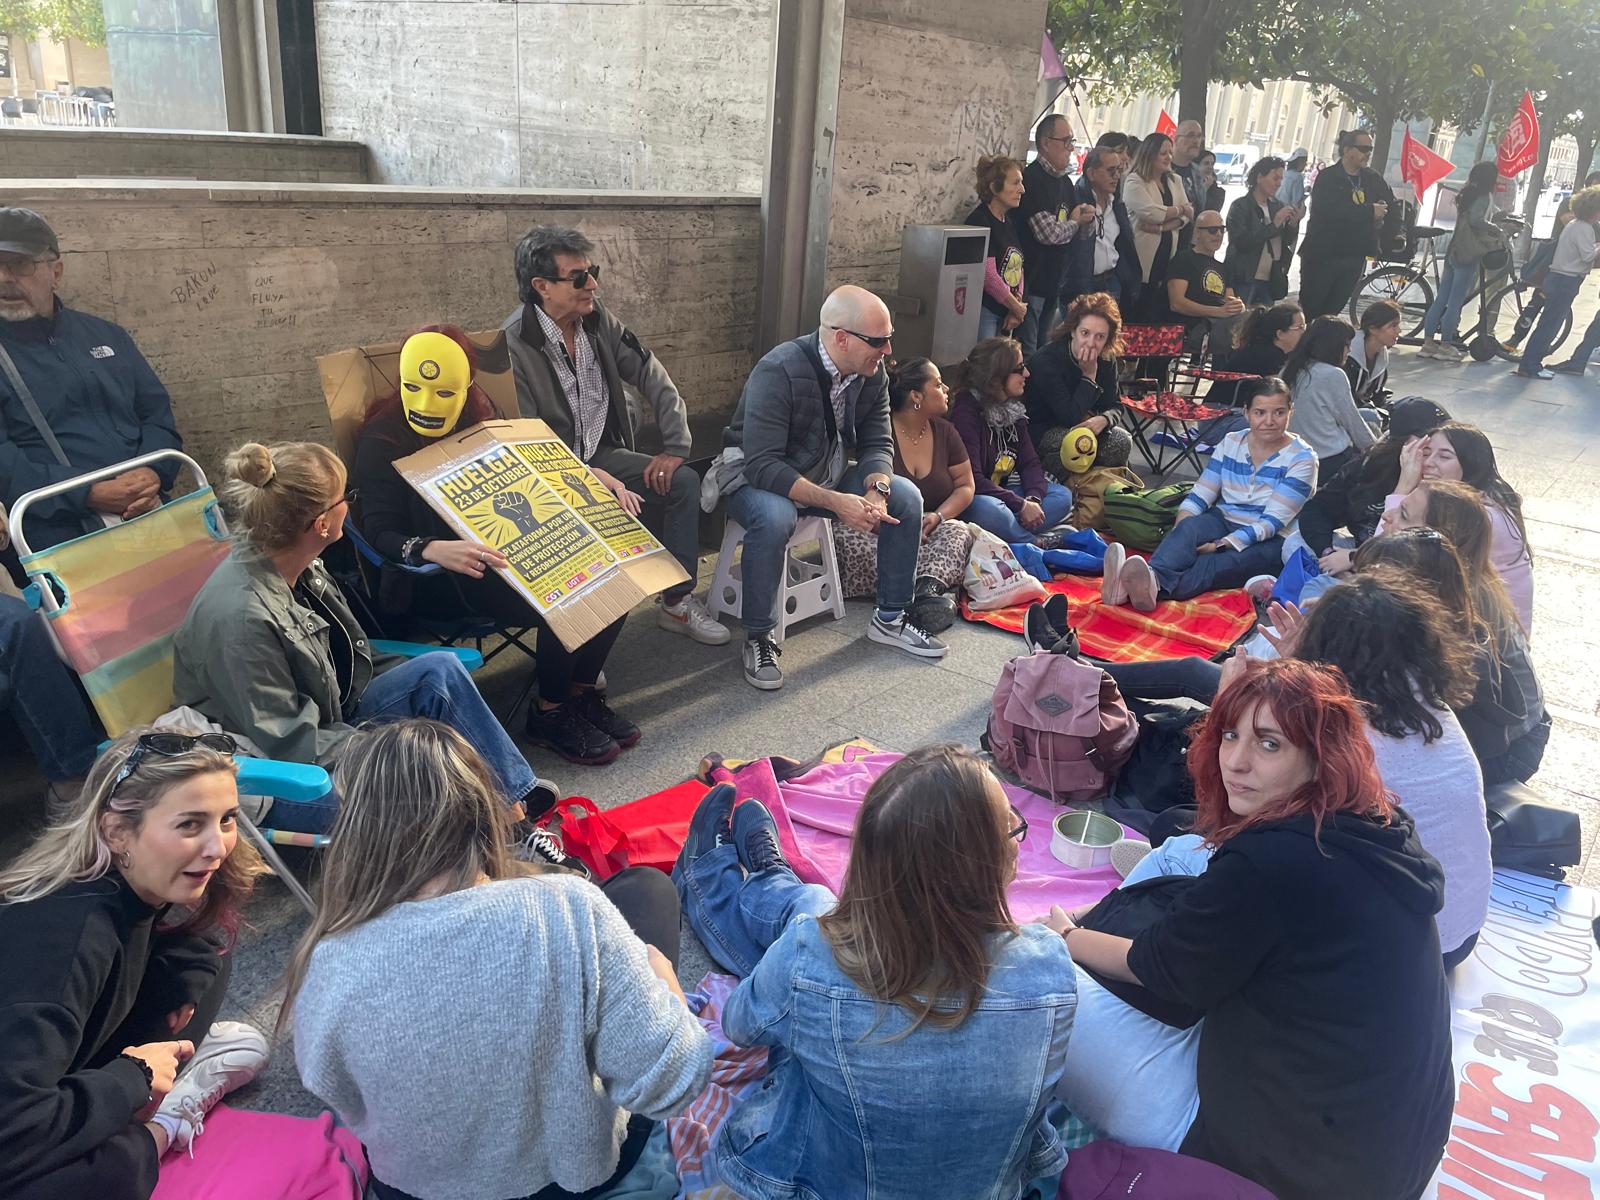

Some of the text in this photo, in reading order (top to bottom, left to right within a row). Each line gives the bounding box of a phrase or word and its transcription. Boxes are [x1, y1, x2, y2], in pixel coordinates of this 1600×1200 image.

[437, 447, 519, 498] HUELGA
[516, 442, 571, 462] HUELGA
[454, 464, 530, 509] 23 DE OCTUBRE
[502, 526, 550, 556] PLATAFORMA
[547, 518, 562, 530] POR
[561, 511, 574, 521] UN
[509, 542, 542, 565] CONVENIO
[540, 519, 580, 548] AUTONÓMICO
[521, 559, 536, 570] DE
[534, 529, 581, 563] PROTECCIÓN
[524, 573, 532, 581] Y
[529, 556, 560, 578] REFORMA
[558, 549, 569, 559] DE
[566, 576, 581, 589] UGT
[545, 588, 562, 603] CGT
